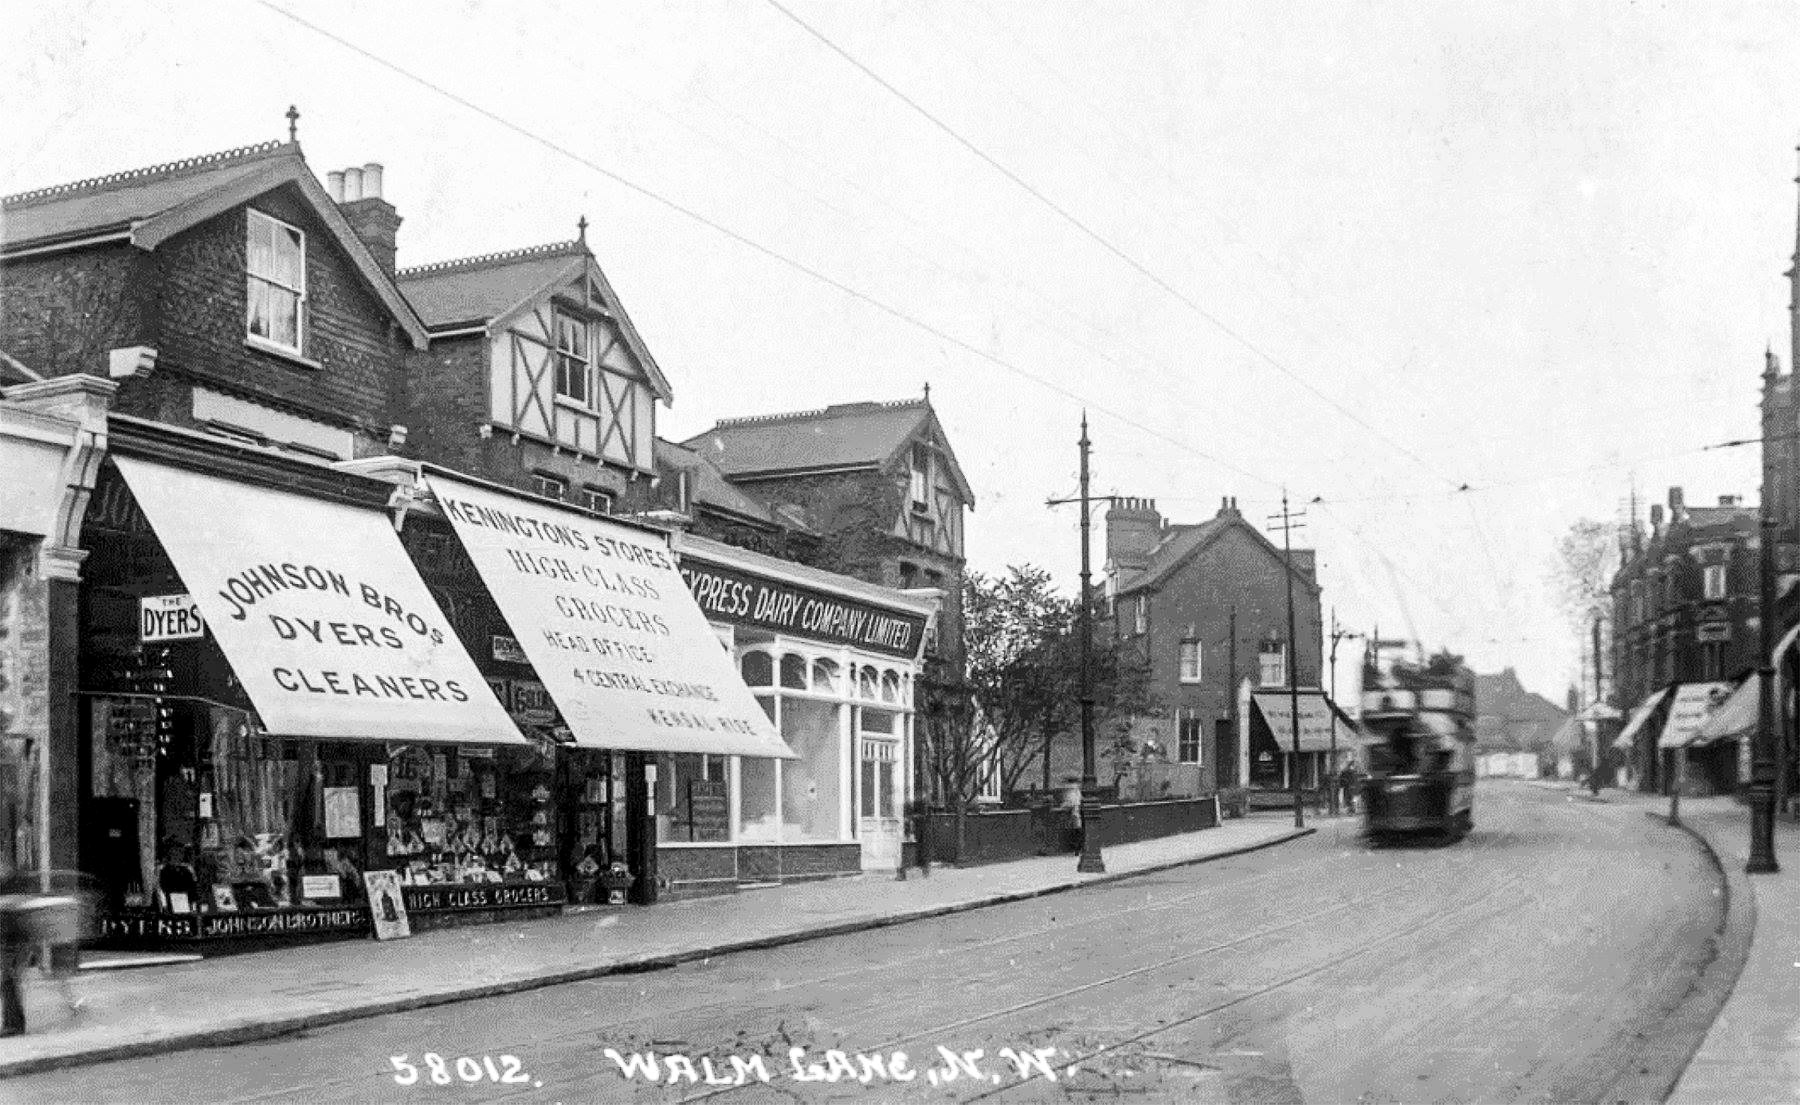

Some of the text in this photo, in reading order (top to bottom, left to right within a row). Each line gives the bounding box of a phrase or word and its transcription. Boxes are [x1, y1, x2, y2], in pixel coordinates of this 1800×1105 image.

[594, 535, 671, 570] STORES
[219, 563, 350, 621] JOHNSON
[754, 587, 803, 626] DAIRY
[144, 603, 201, 637] DYERS
[269, 614, 404, 649] DYERS
[556, 595, 670, 637] GROCERS
[543, 629, 590, 653] HEAD
[592, 638, 653, 663] OFFICE
[273, 667, 469, 702] CLEANERS
